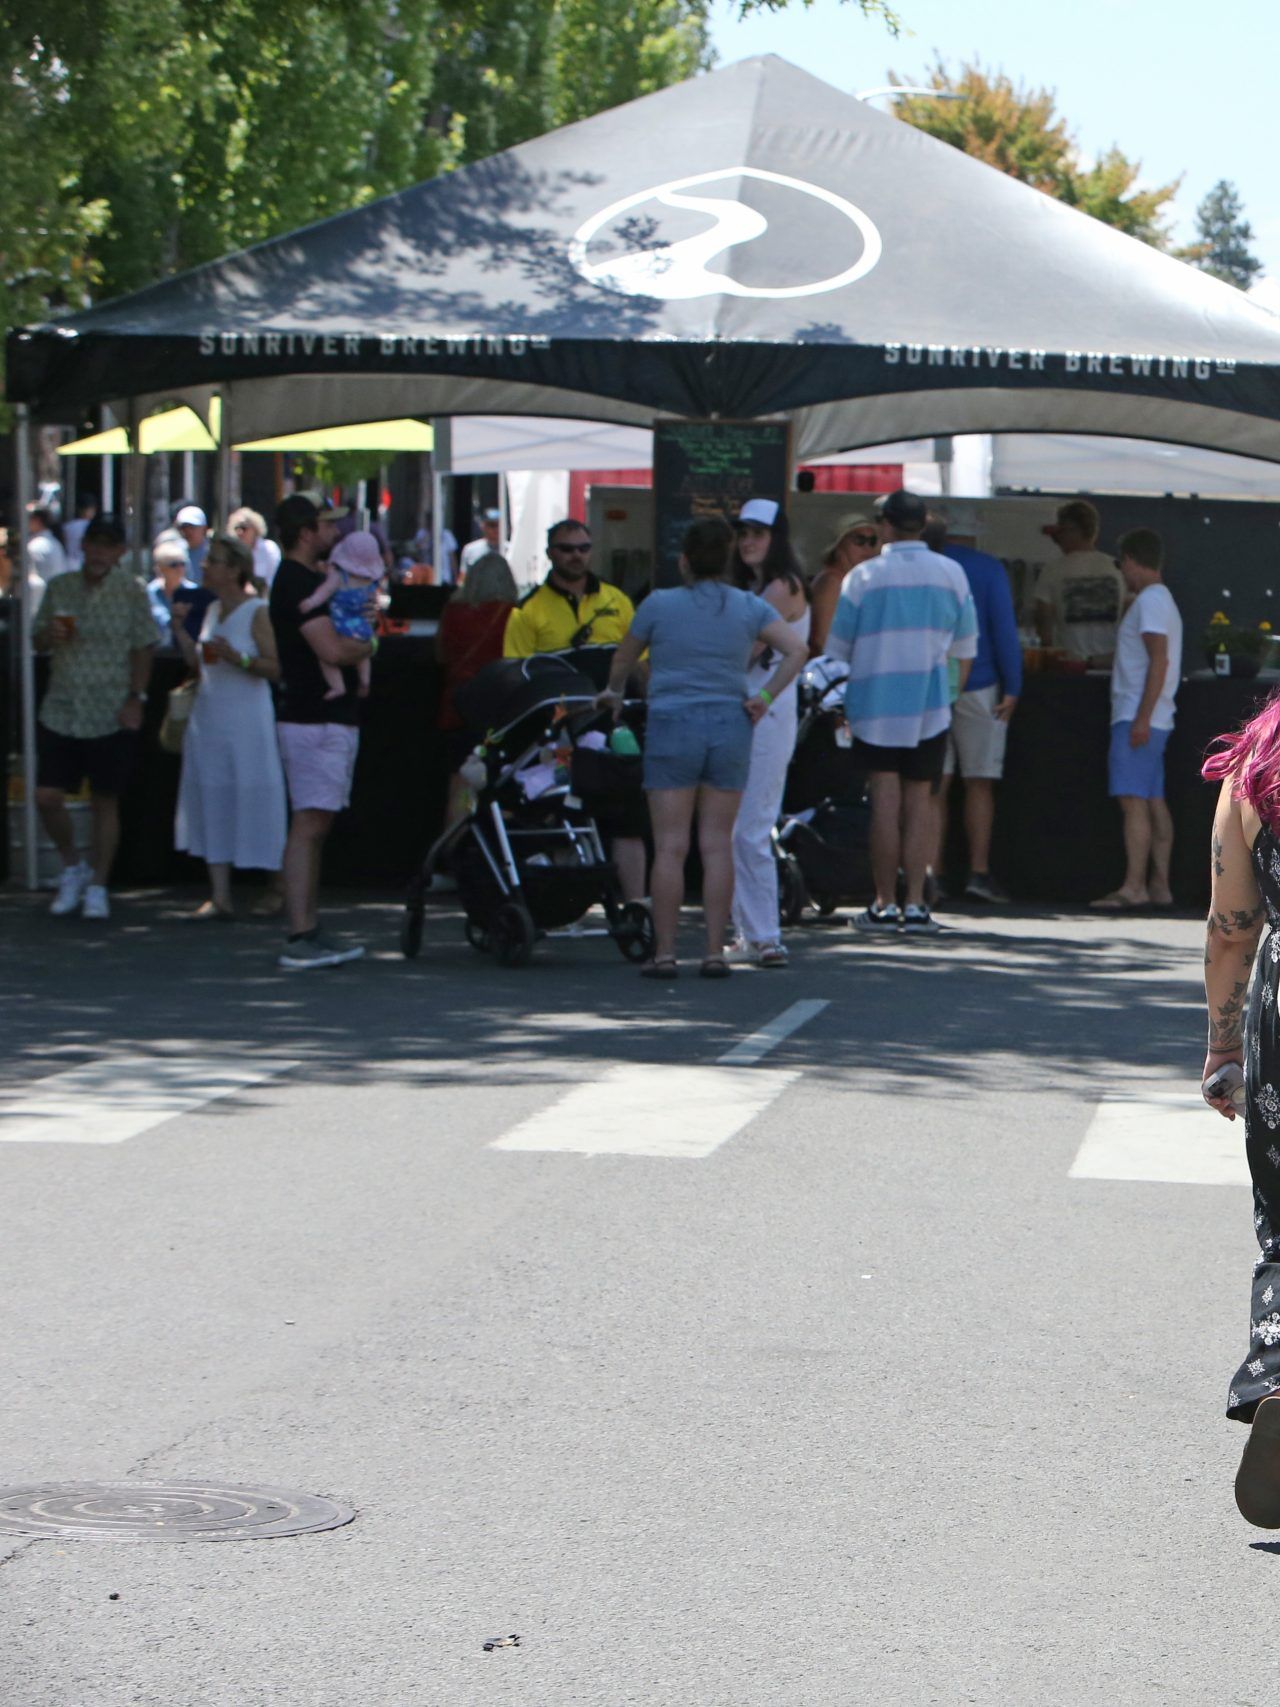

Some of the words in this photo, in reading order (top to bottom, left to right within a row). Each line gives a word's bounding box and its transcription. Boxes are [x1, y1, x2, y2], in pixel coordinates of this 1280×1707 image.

[200, 330, 361, 356] SUNRIVER
[379, 333, 527, 356] BREWING
[884, 342, 1047, 370] SUNRIVER
[1065, 350, 1211, 380] BREWING
